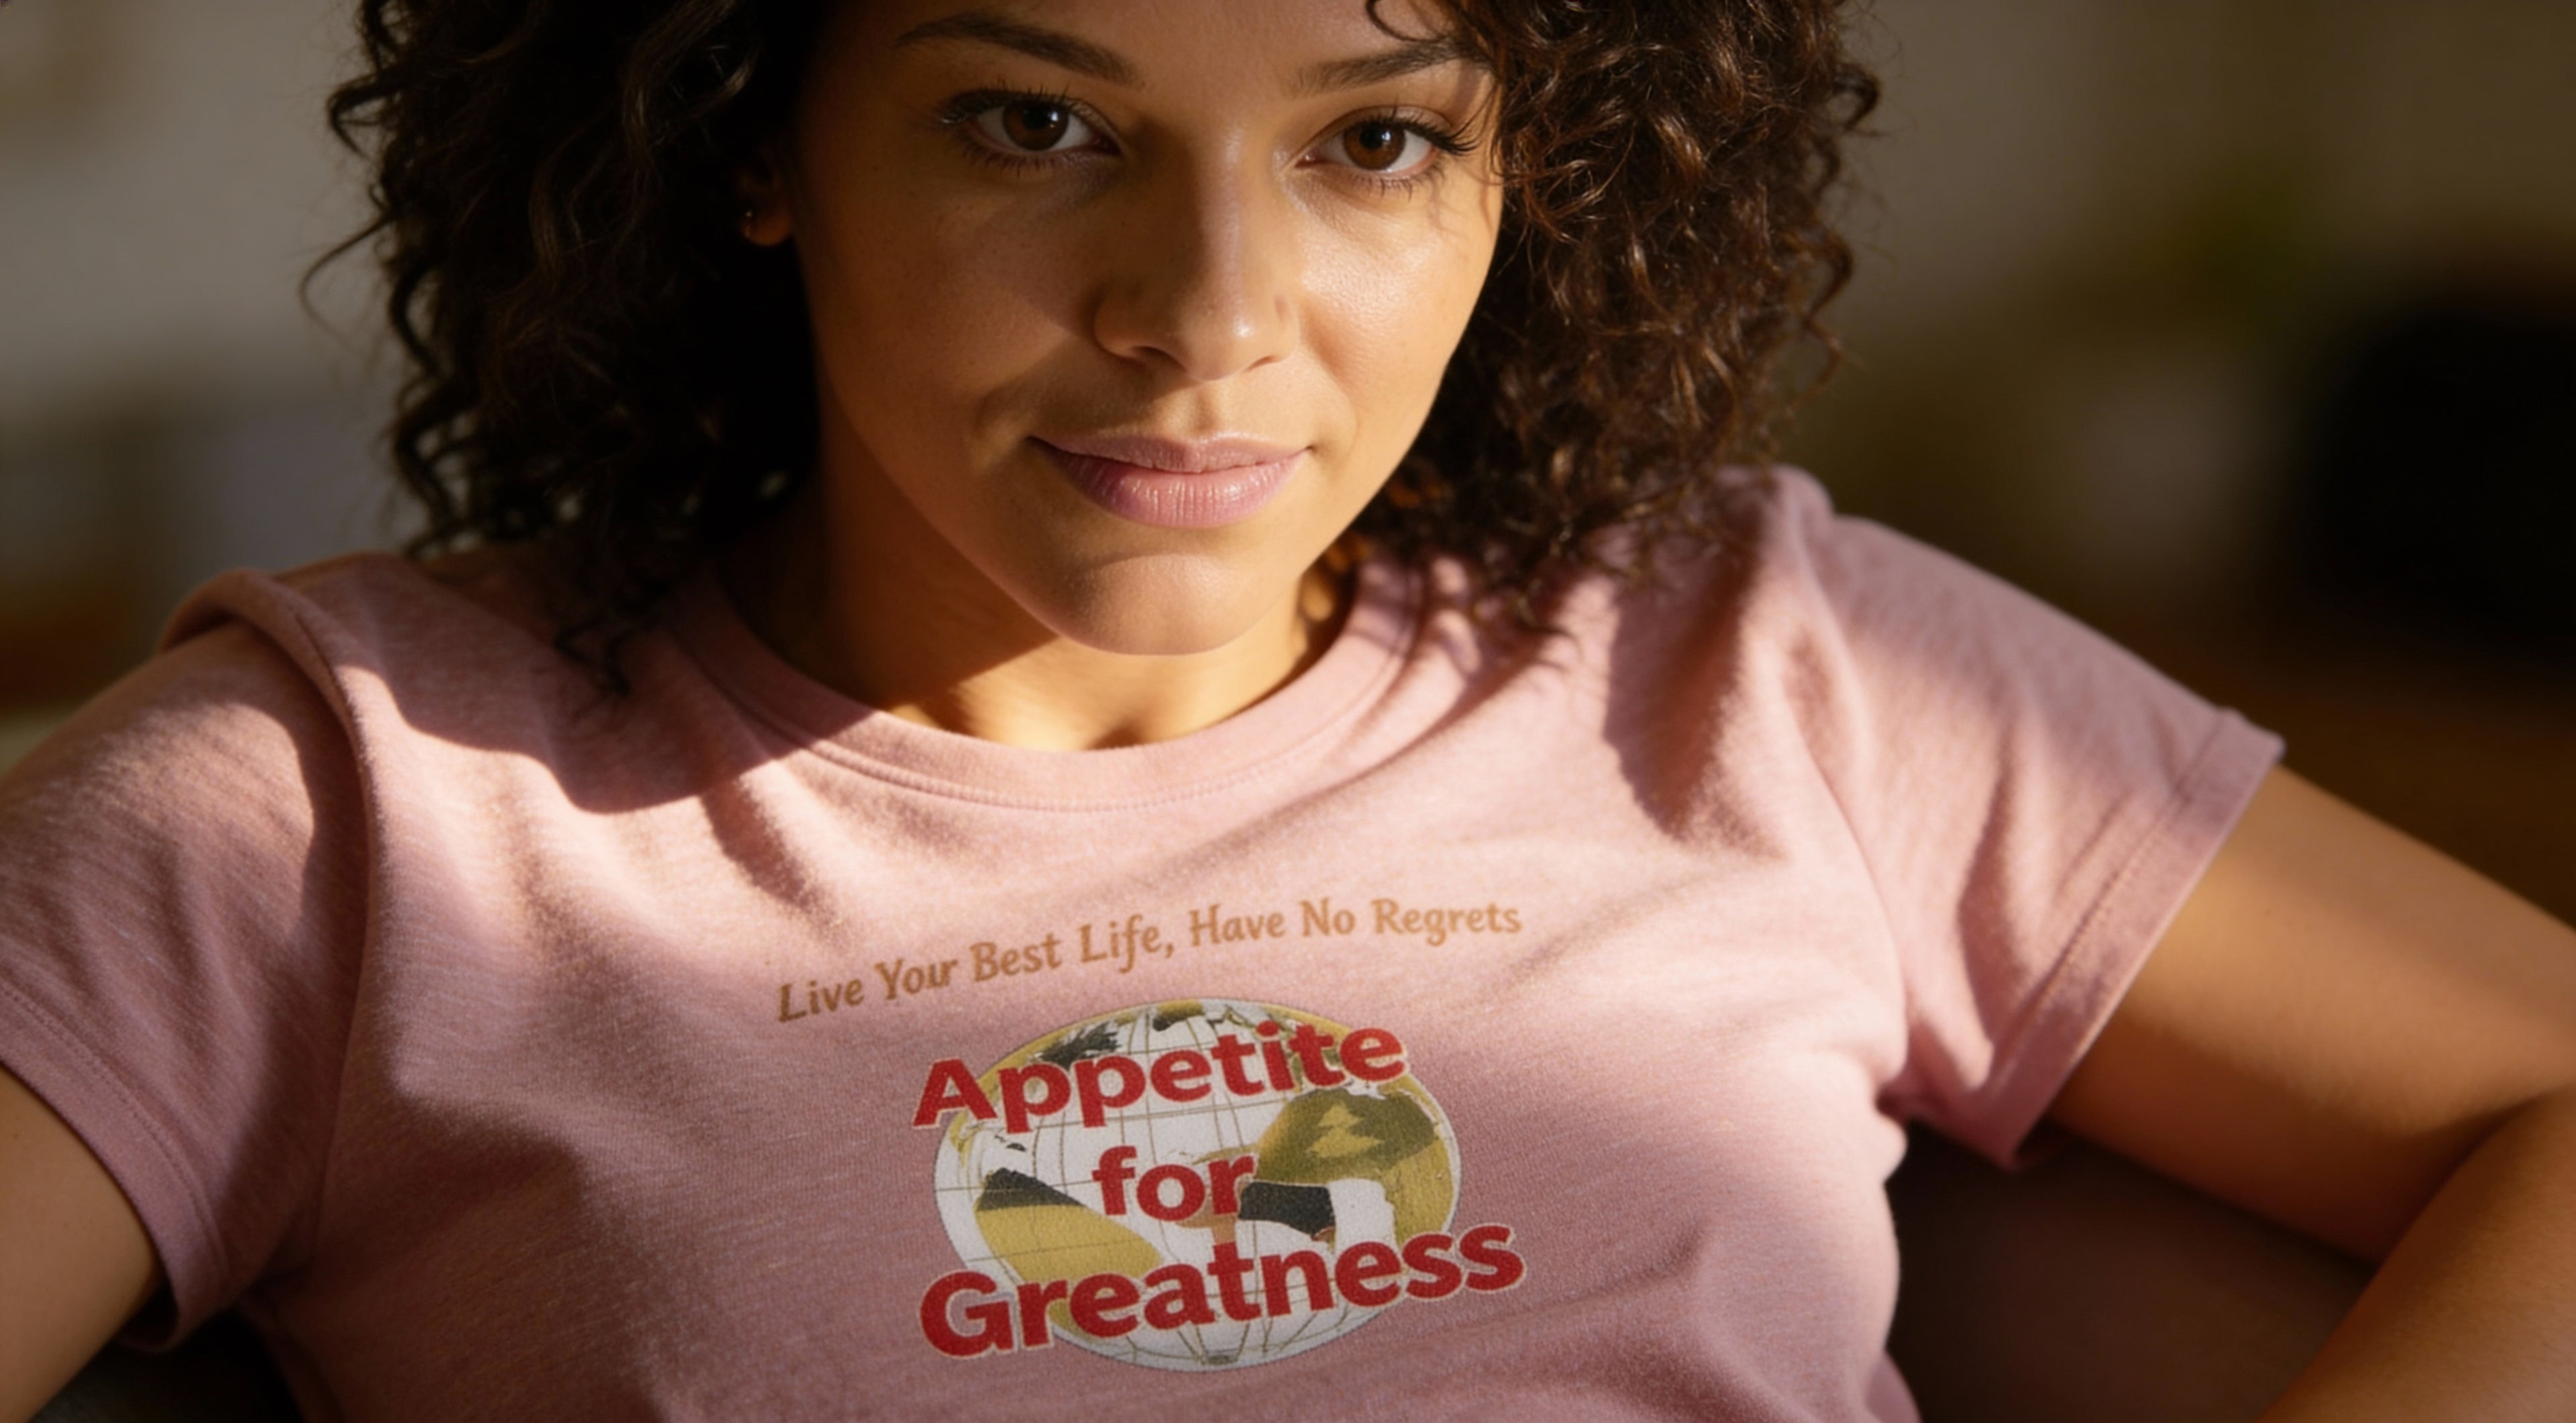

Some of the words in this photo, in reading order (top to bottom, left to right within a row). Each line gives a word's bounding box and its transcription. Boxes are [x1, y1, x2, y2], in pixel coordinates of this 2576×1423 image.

[777, 977, 865, 1023] Live
[874, 958, 959, 1000] Your
[969, 933, 1062, 982] Best
[1079, 913, 1174, 974] Life,
[1188, 903, 1287, 947] Have
[1299, 897, 1356, 937] No
[1370, 898, 1522, 947] Regrets
[912, 1020, 1408, 1134] Appetite
[1092, 1145, 1256, 1222] for
[918, 1223, 1527, 1359] Greatness
